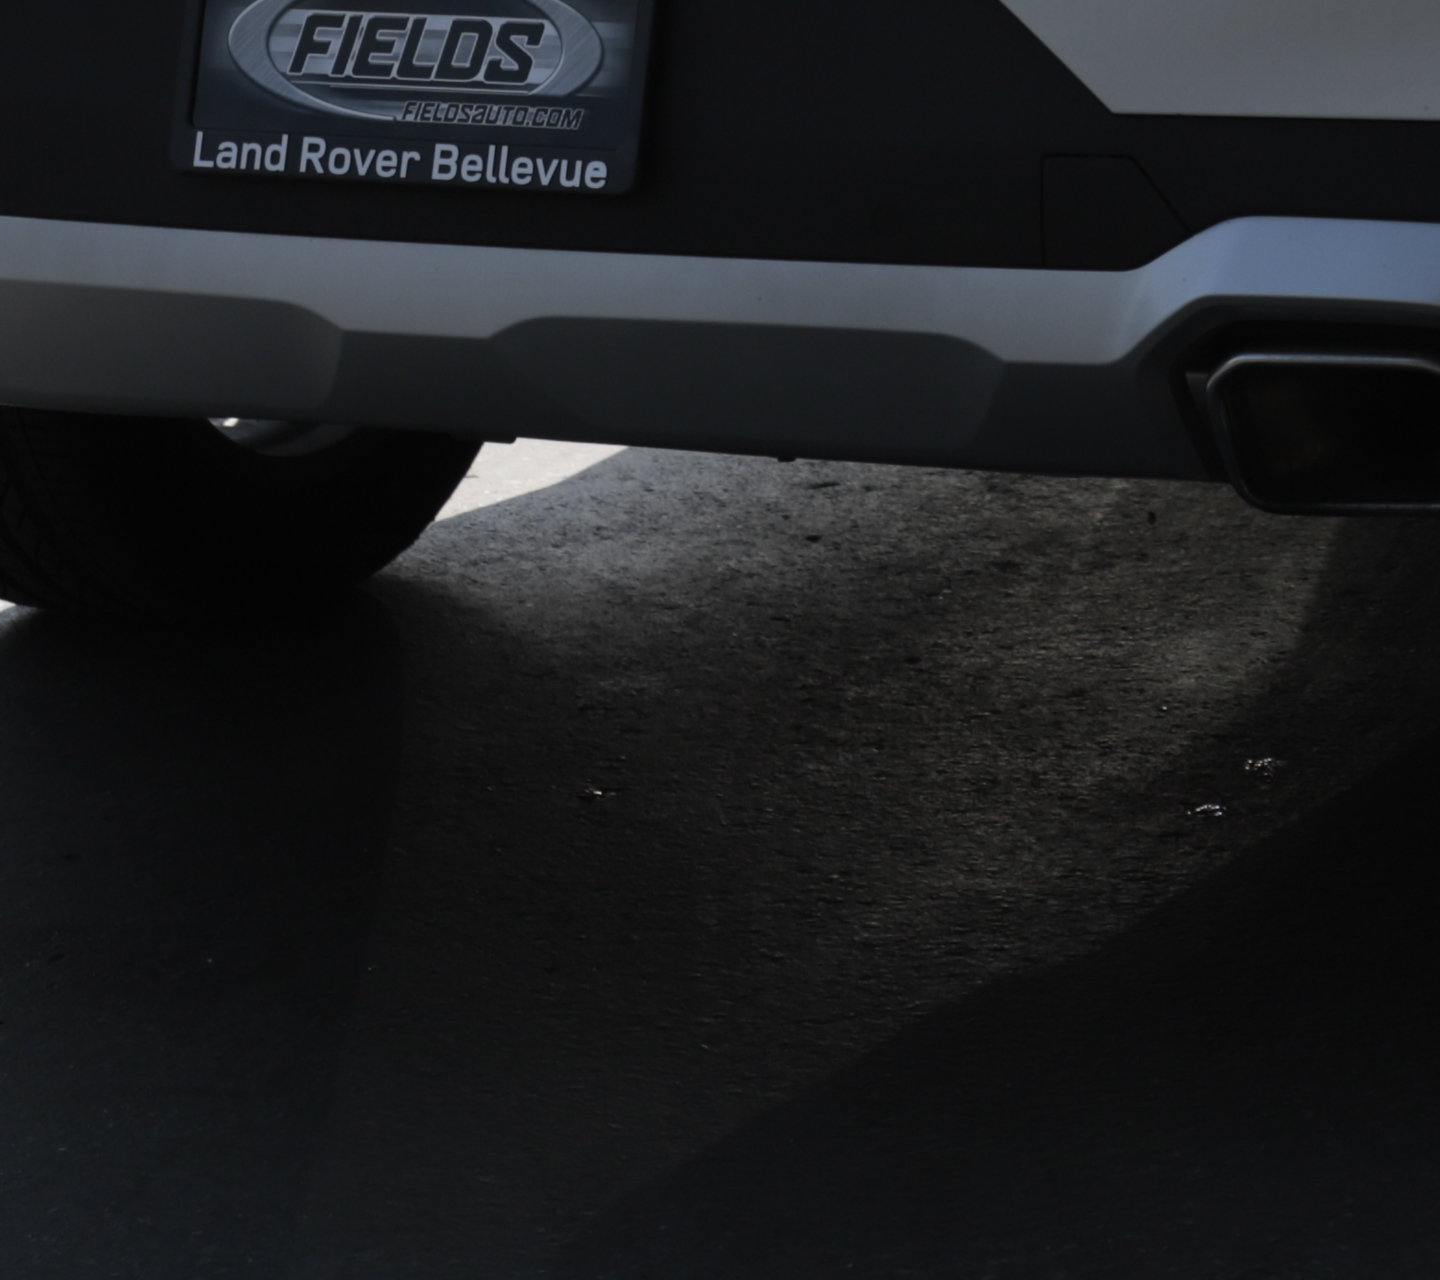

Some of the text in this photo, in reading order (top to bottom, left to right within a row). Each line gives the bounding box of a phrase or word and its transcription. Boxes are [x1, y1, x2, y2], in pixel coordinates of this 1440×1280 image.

[288, 13, 546, 85] FIELDS
[193, 130, 609, 189] Land Rover Bellevue
